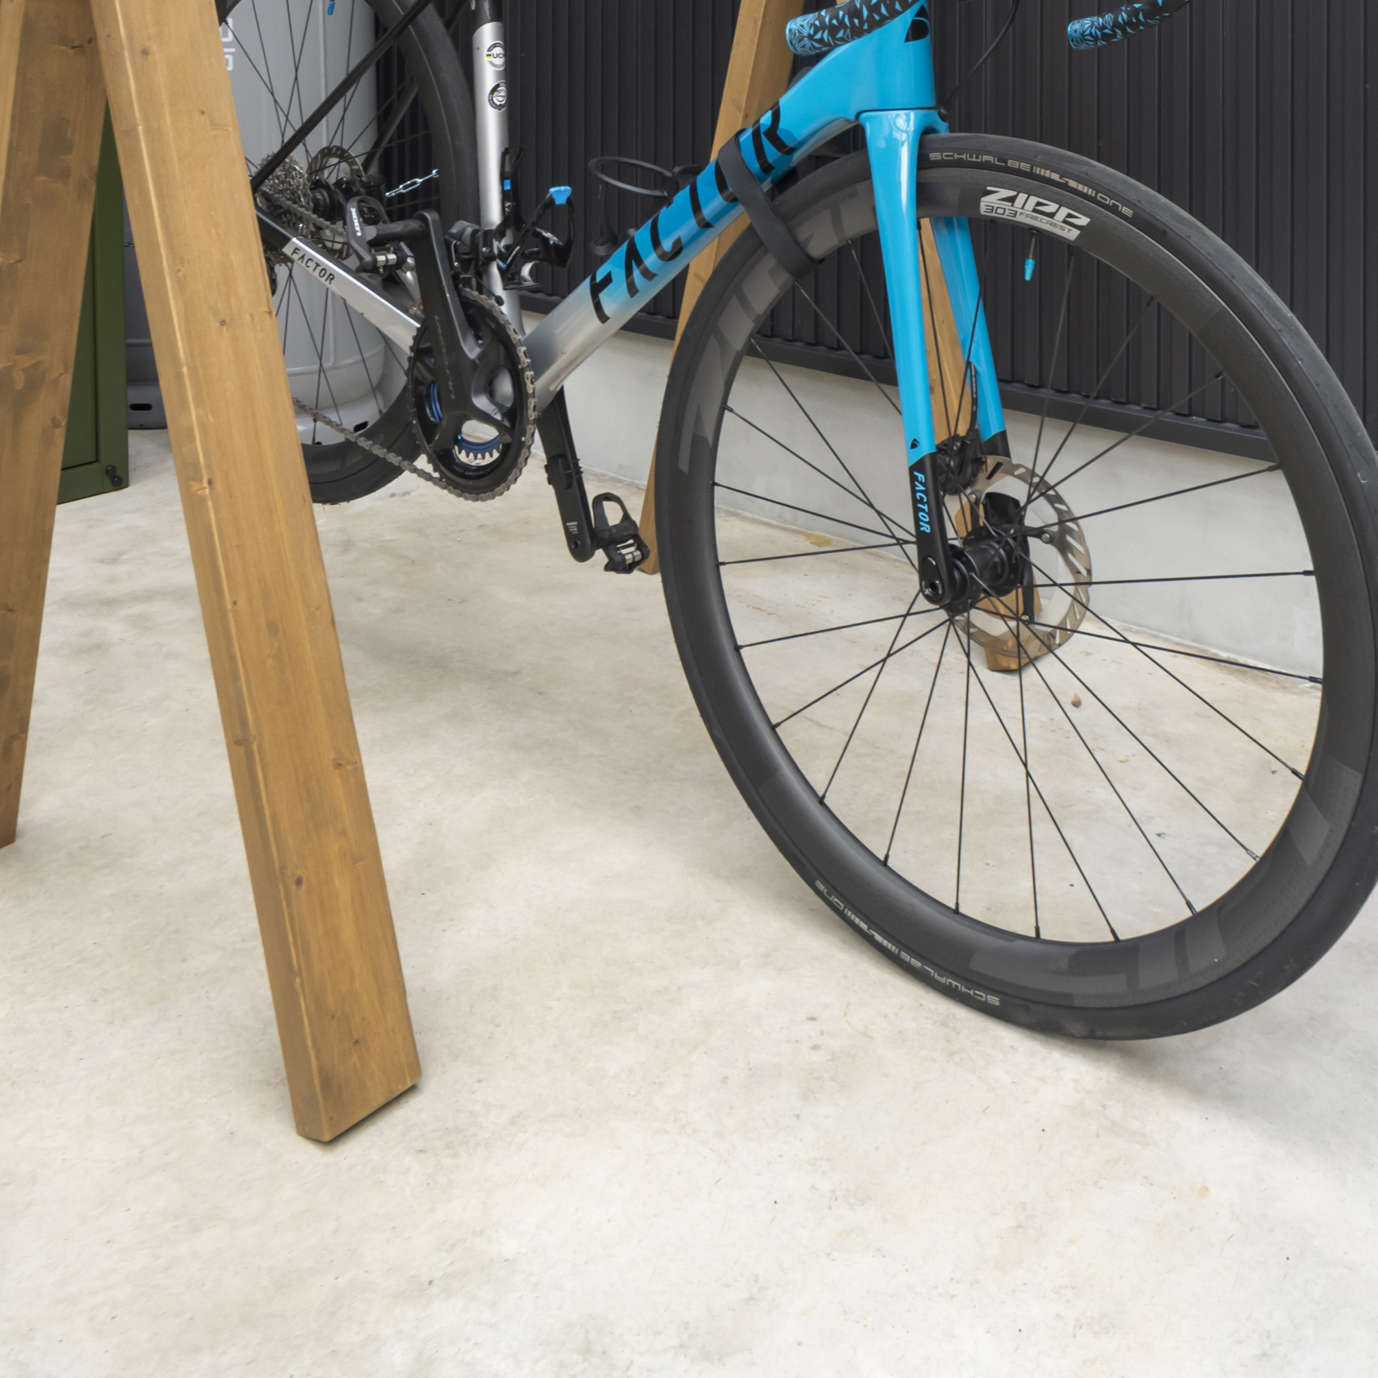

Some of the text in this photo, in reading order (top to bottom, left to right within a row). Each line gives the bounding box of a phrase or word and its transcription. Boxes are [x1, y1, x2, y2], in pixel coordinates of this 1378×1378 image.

[928, 152, 1134, 218] SCHWALBE ONE
[980, 185, 1091, 227] ZIPP
[983, 204, 1074, 234] 303 FIRECREST
[290, 247, 336, 285] FACTOR
[913, 470, 931, 533] FACTOR
[899, 950, 1000, 1006] SCHWALBE
